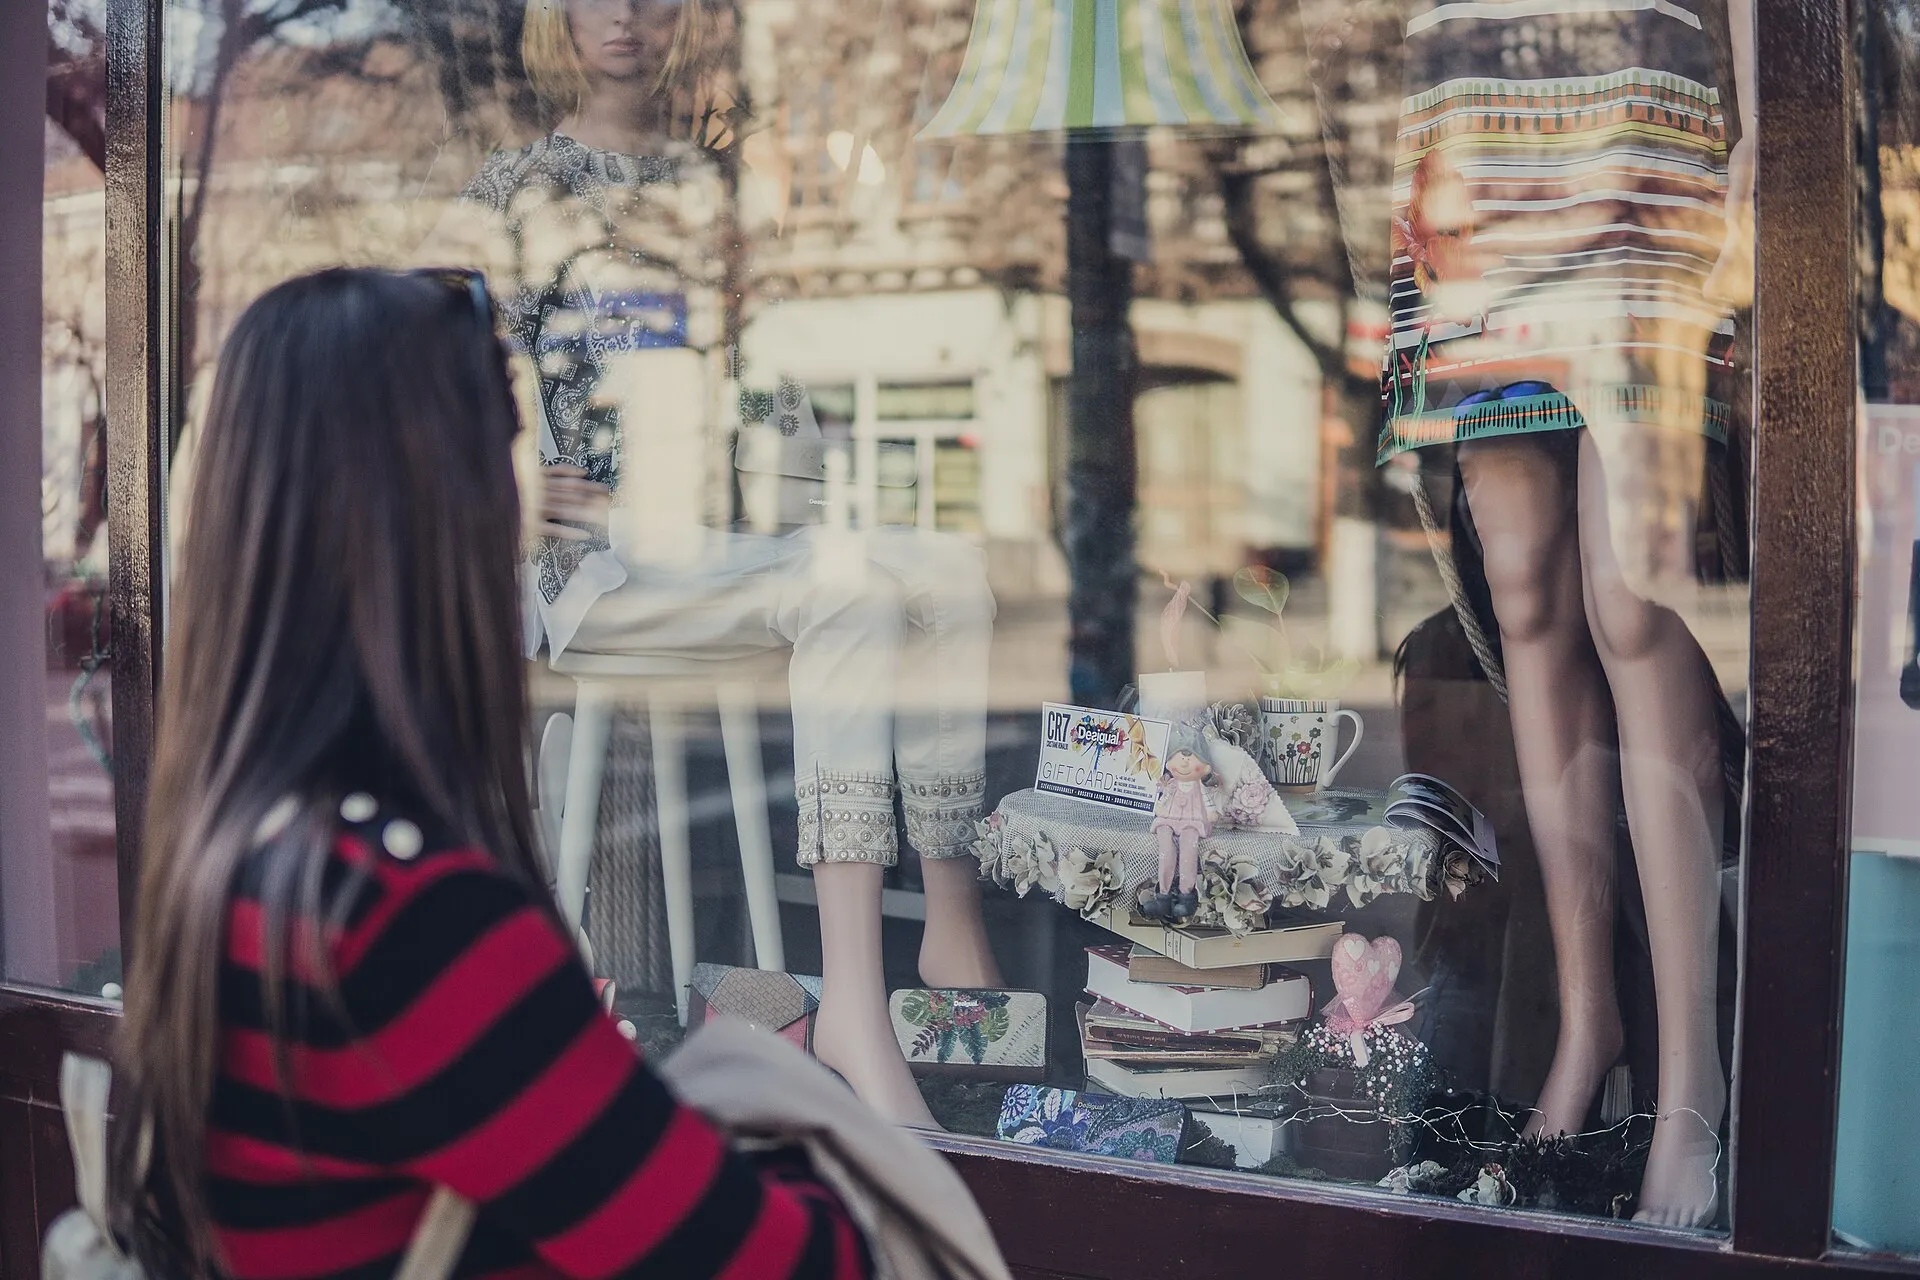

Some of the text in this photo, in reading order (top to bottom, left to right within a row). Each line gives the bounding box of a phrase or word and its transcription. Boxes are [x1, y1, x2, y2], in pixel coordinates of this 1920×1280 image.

[1047, 710, 1071, 743] CR7
[1077, 726, 1120, 746] Desigual
[1042, 761, 1074, 779] GIFT
[1075, 768, 1114, 791] CARD
[1076, 1101, 1105, 1111] Desigual
